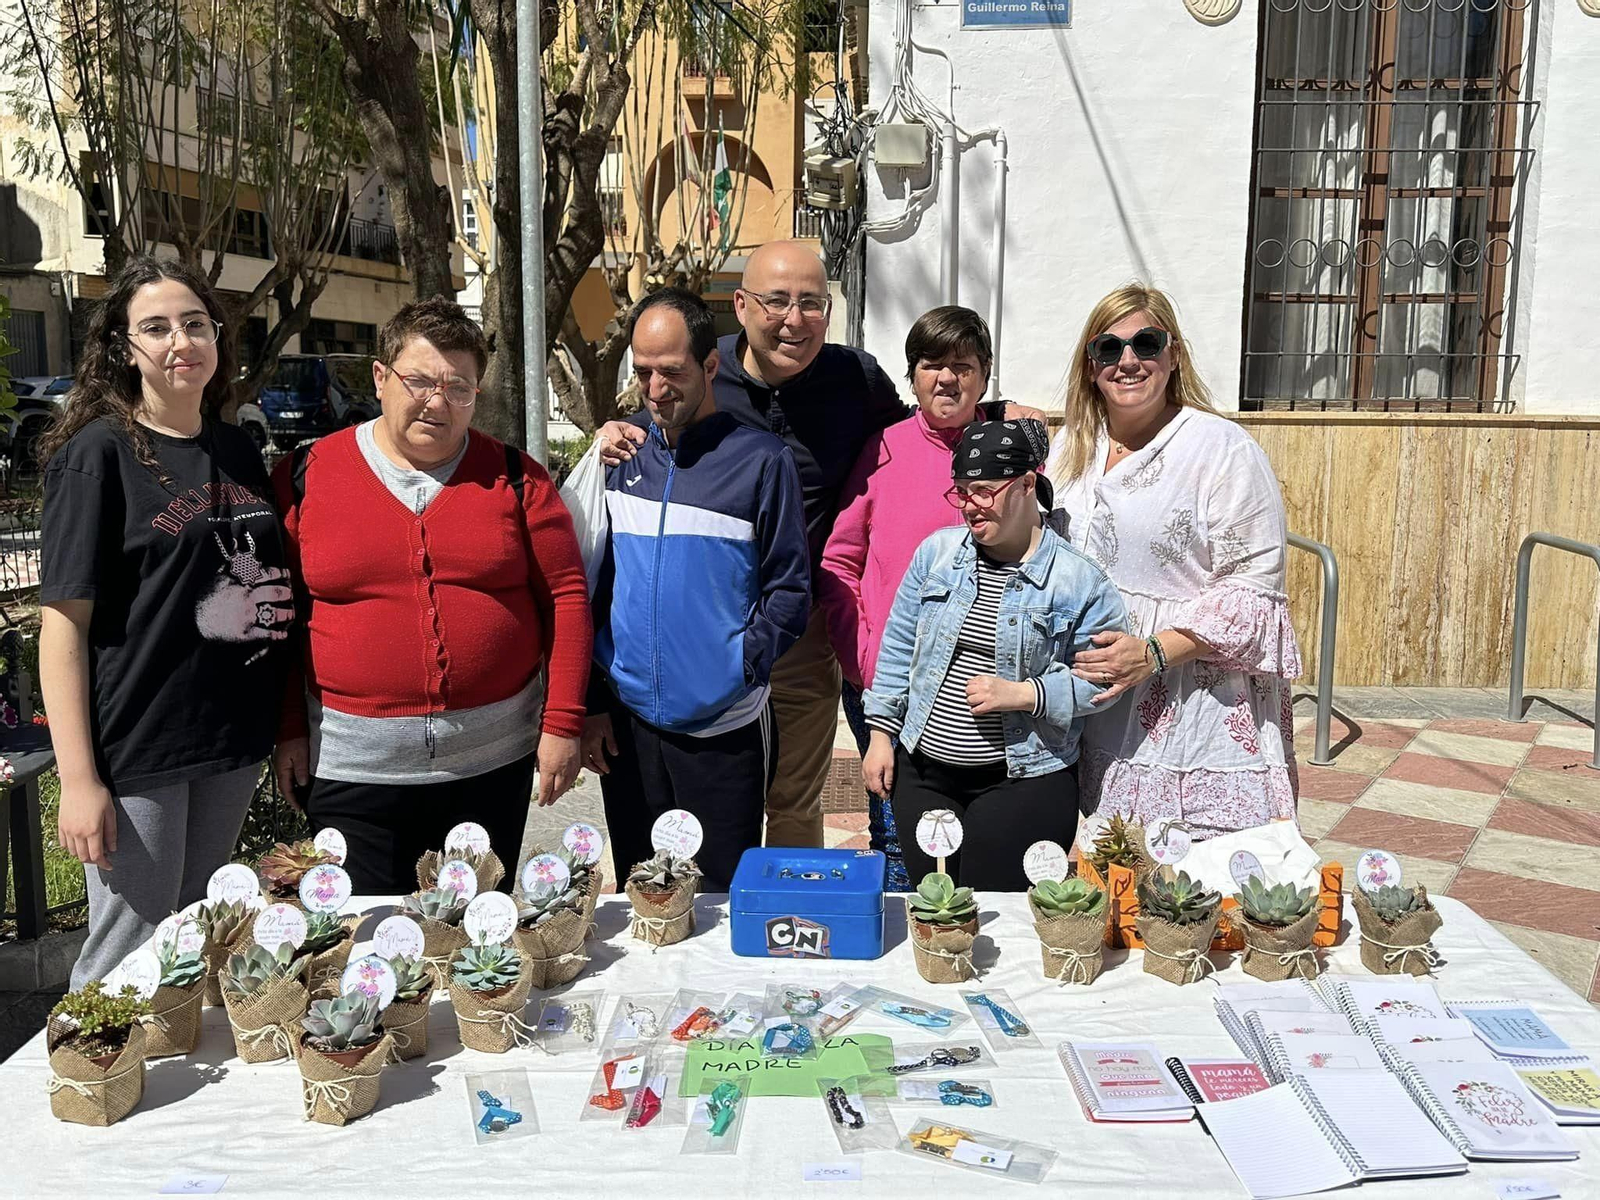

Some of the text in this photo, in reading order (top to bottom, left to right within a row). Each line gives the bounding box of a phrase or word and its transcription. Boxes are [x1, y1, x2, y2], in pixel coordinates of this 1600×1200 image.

[967, 1, 1065, 13] Guillermo Reina
[771, 922, 818, 951] CN
[824, 1037, 859, 1049] LA
[702, 1058, 802, 1072] MADRE
[1201, 1066, 1257, 1078] mamá
